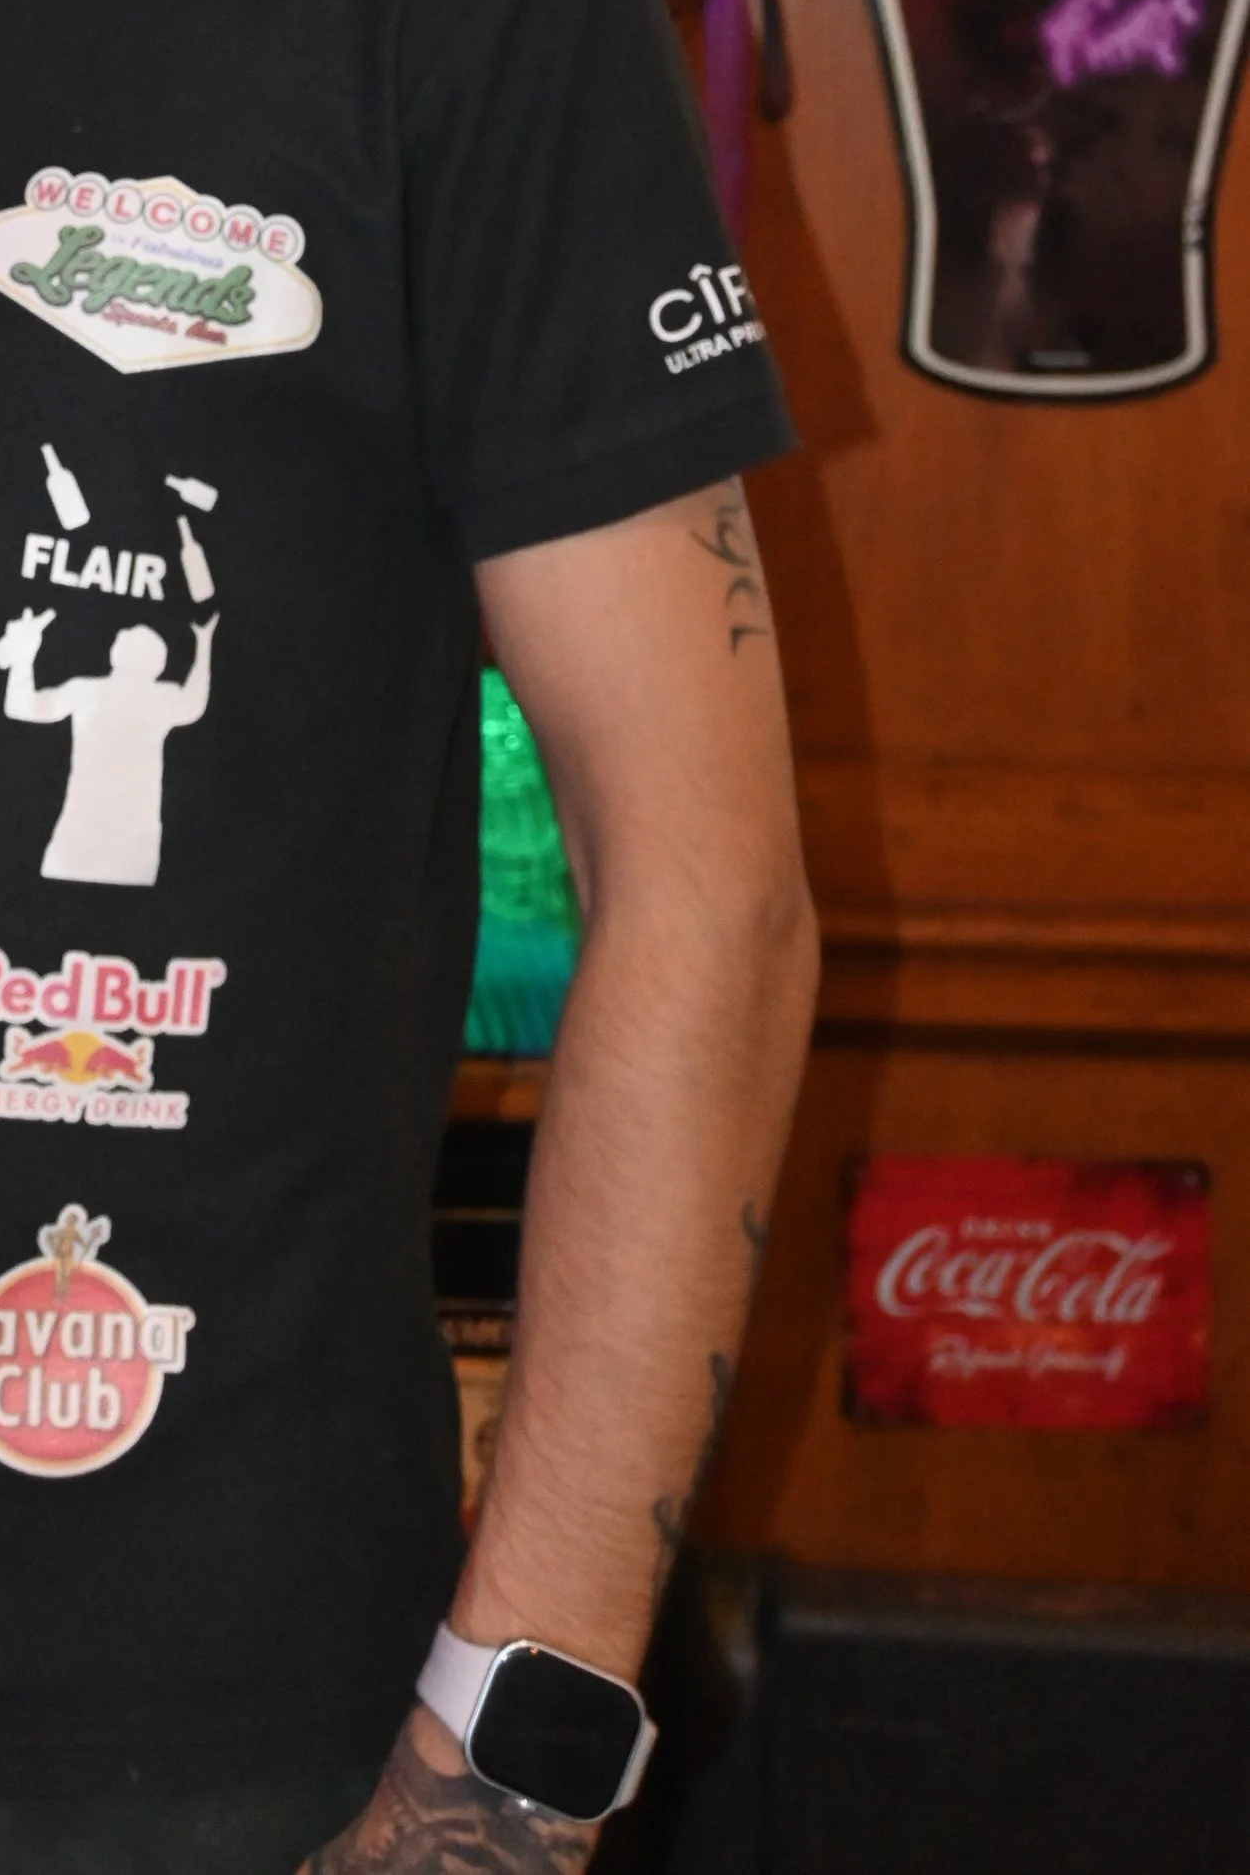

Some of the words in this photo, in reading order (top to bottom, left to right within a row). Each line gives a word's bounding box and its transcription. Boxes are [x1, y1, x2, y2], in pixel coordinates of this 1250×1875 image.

[33, 177, 291, 255] WELCOME
[9, 224, 257, 326] Legends
[663, 332, 733, 375] ULTRA
[20, 531, 168, 602] FLAIR
[93, 963, 210, 1030] Bull
[93, 1093, 186, 1124] DRINK
